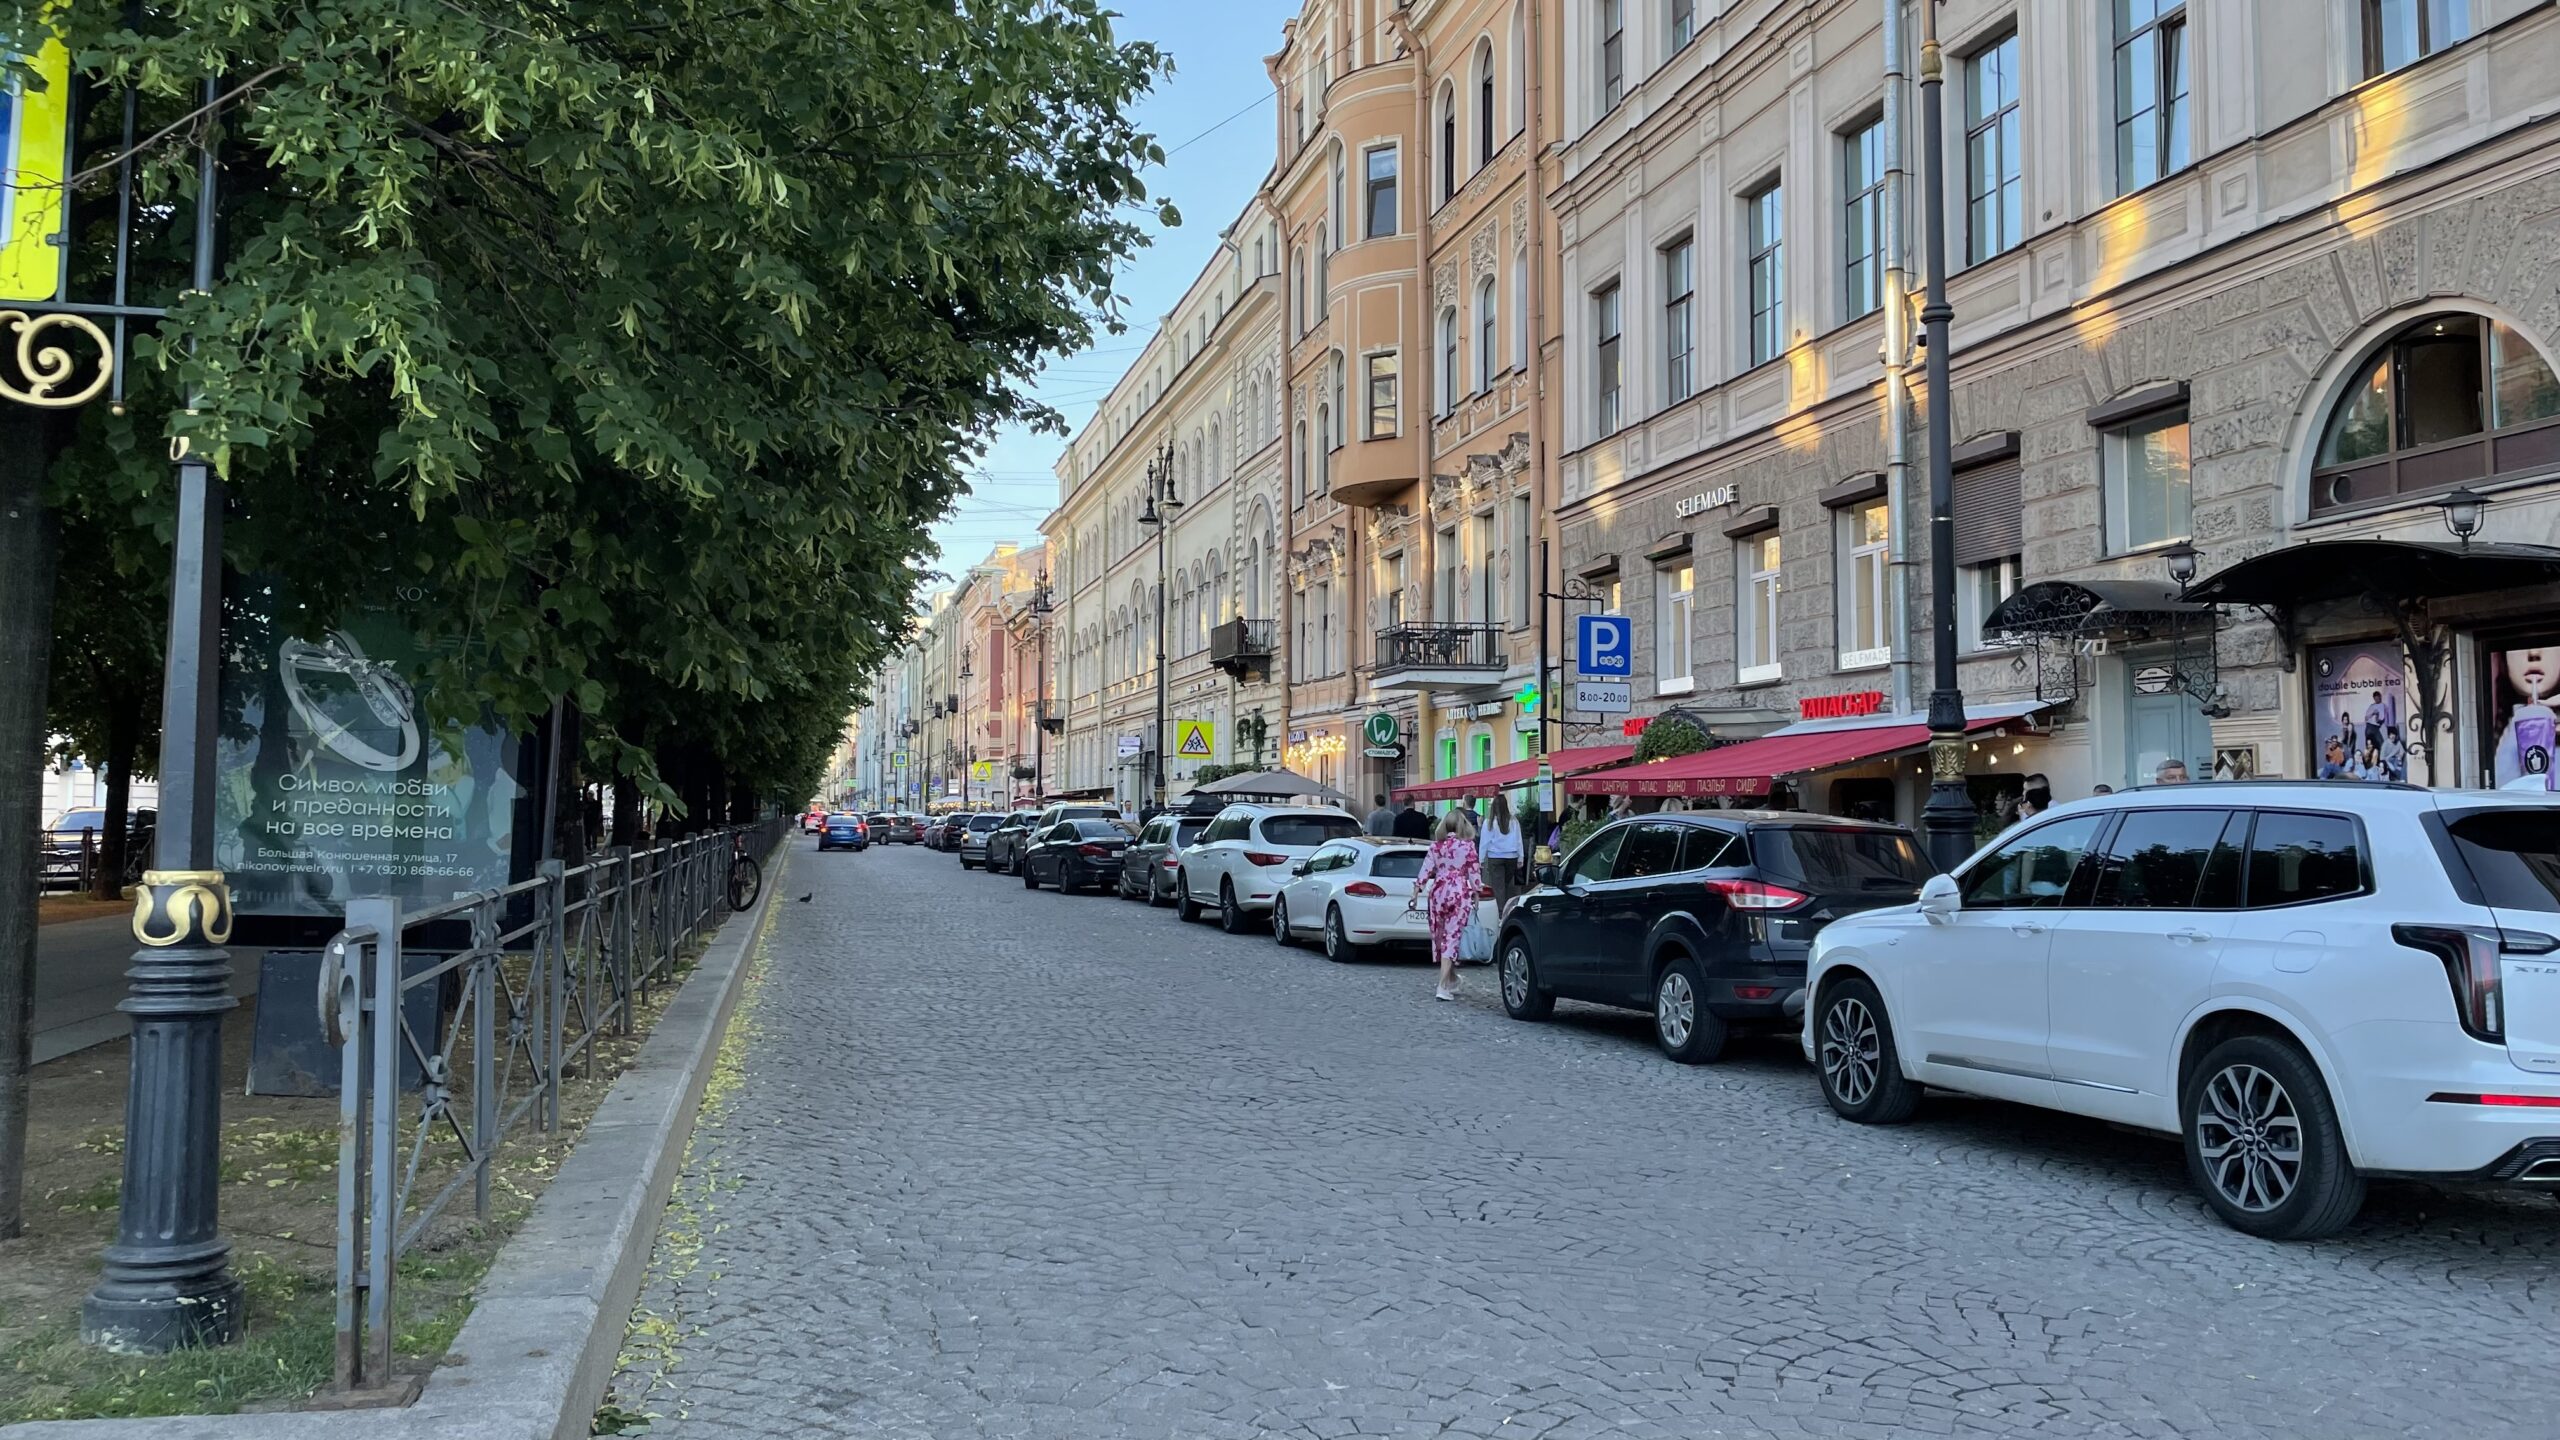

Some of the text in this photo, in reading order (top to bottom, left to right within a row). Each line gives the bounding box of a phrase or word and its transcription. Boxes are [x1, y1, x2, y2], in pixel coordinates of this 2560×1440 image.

[1675, 483, 1738, 519] SELFMADE
[1590, 621, 1620, 667] P
[1843, 648, 1890, 667] SELFMADE
[2318, 674, 2401, 692] double bubble tea
[278, 774, 448, 796] Символ любви
[1574, 778, 1758, 794] ХАМОН САНГРИЯ ТАПАС ВИНО ПАЭЛЬЯ СИДР
[272, 798, 450, 818] и преданности
[265, 821, 453, 840] на все времена
[257, 847, 458, 864] Большая Конюшенная улица, 17
[237, 860, 344, 875] nikonovjewelry.ru
[358, 864, 374, 875] +7
[377, 864, 407, 876] (921)
[410, 865, 474, 877] 868-66-66
